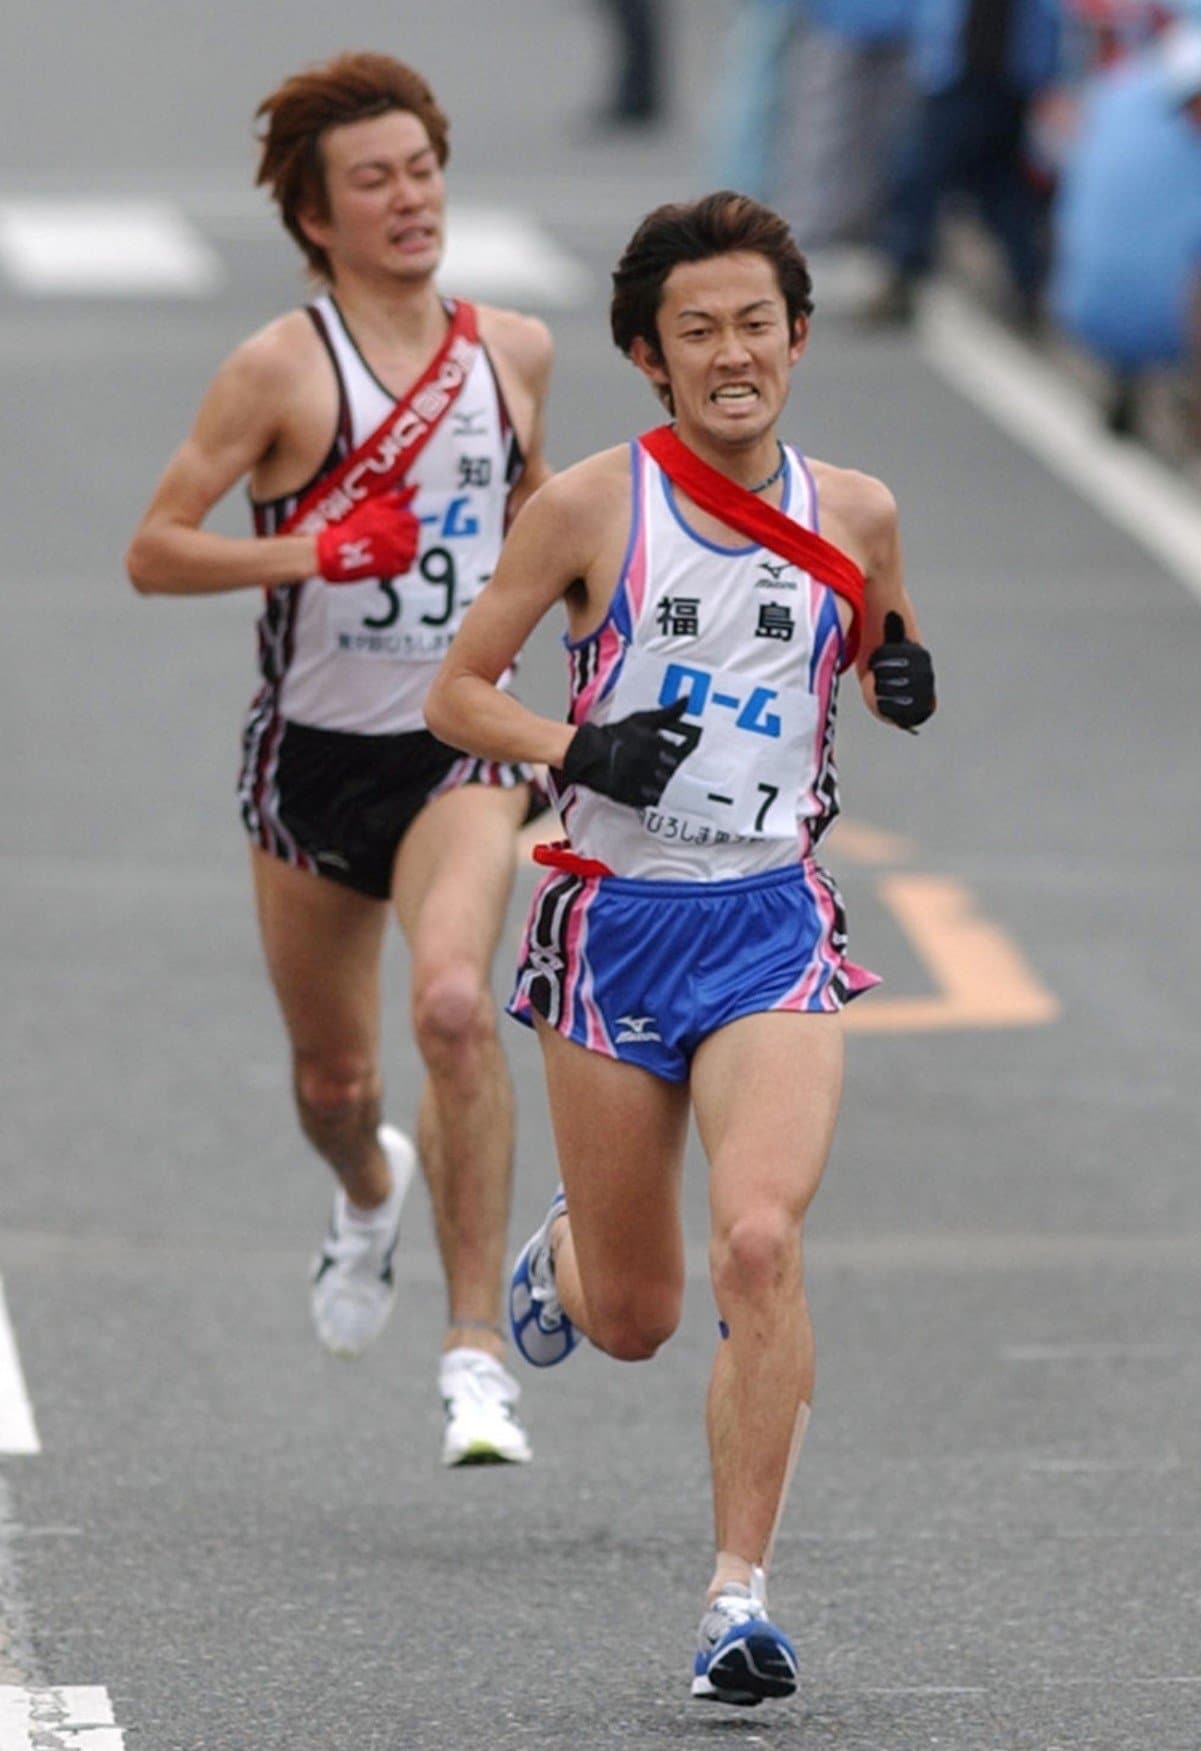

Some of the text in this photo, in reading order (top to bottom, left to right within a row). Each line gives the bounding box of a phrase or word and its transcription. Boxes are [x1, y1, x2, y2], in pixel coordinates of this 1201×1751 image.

[458, 454, 491, 487] 知
[420, 496, 478, 538] ーム
[658, 663, 781, 738] ローム
